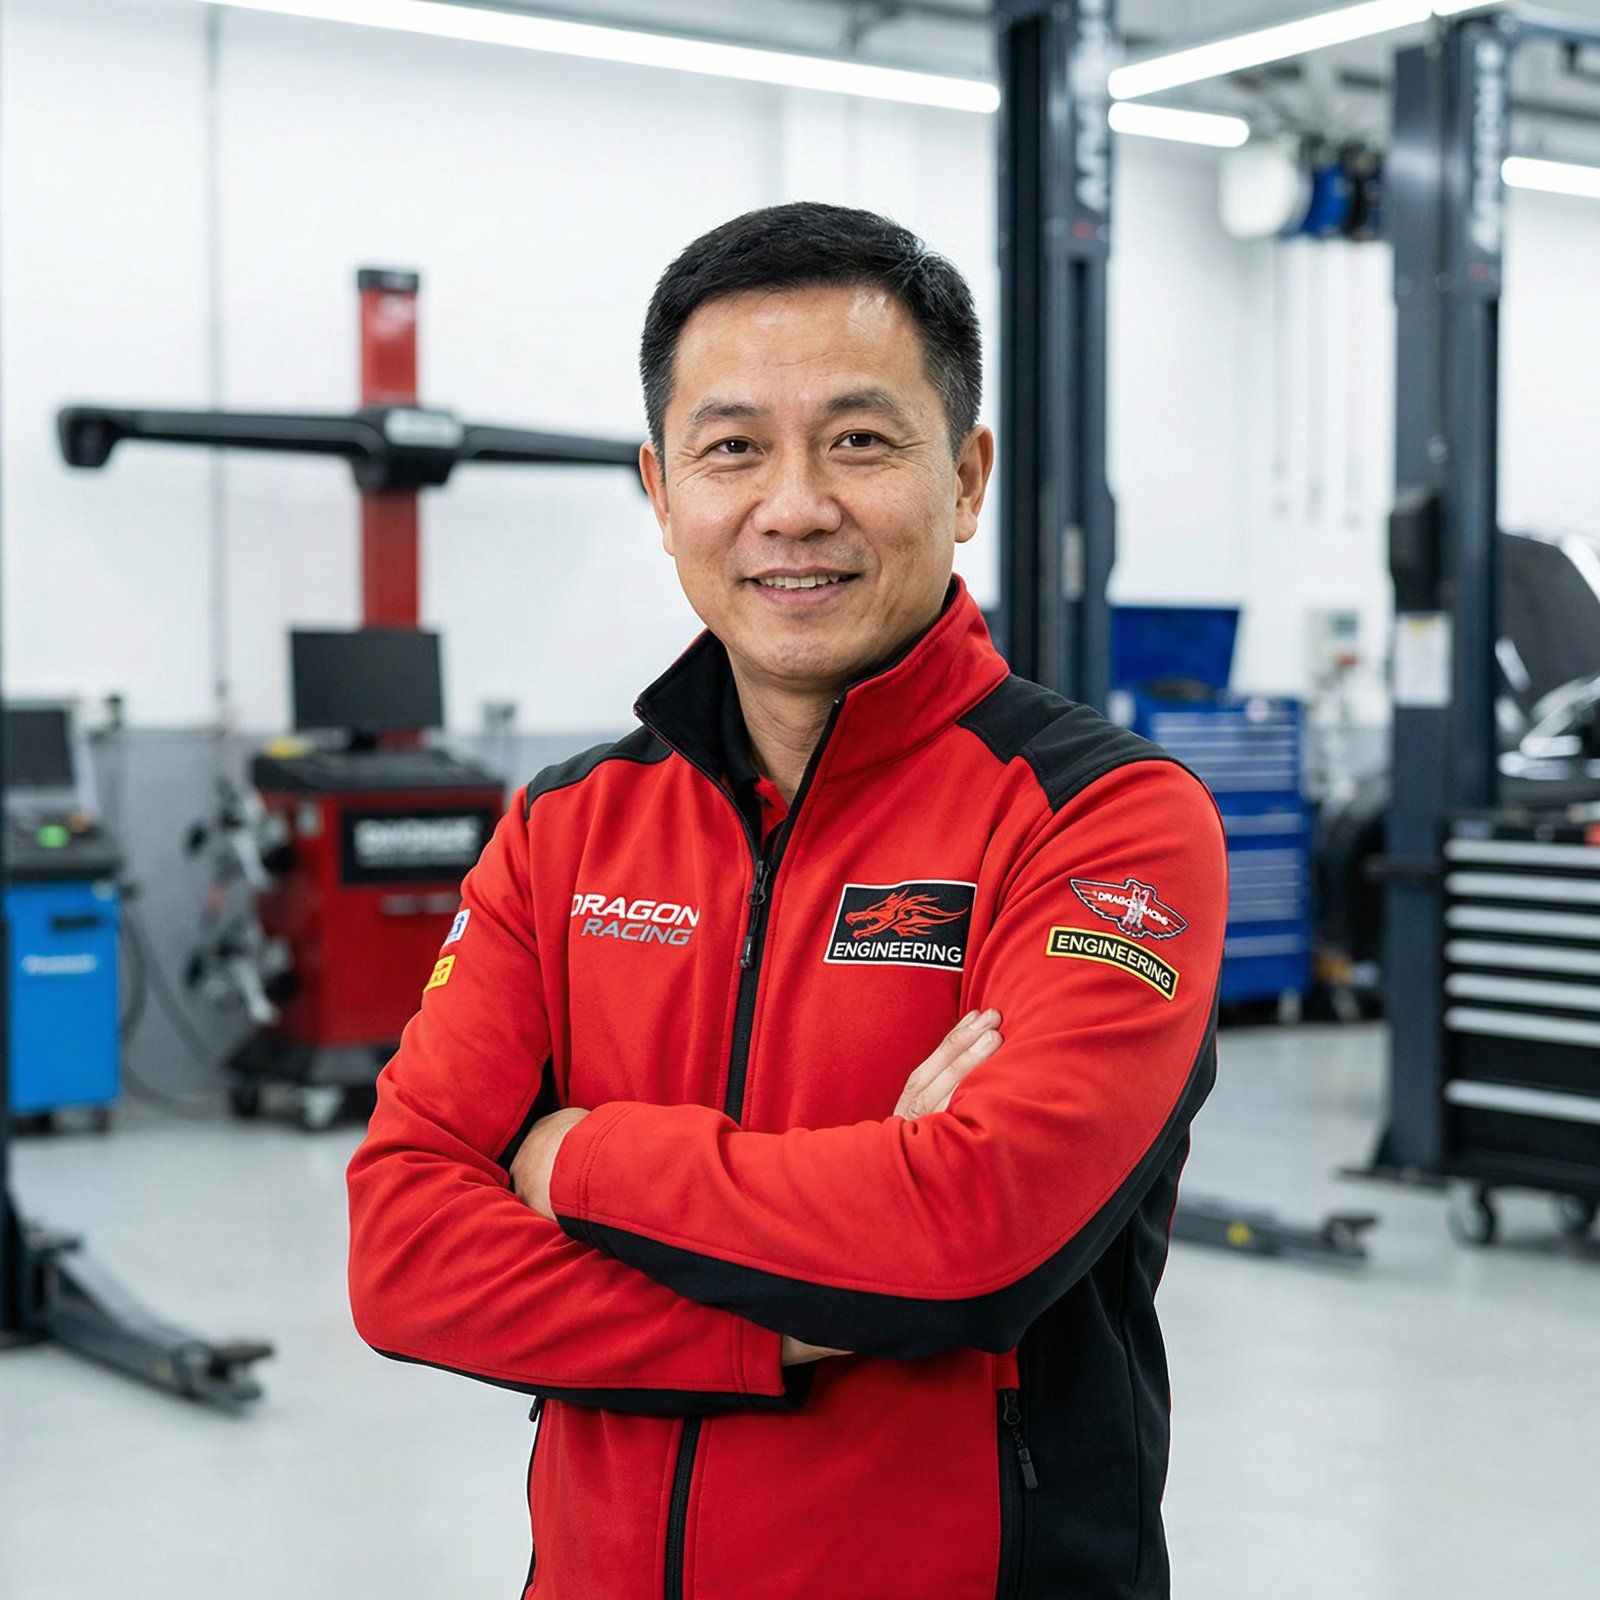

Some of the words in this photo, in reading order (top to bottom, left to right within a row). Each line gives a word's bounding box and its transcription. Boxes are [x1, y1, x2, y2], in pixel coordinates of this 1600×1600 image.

[581, 917, 694, 946] RACING
[833, 942, 963, 963] ENGINEERING
[1056, 934, 1171, 989] ENGINEERING
